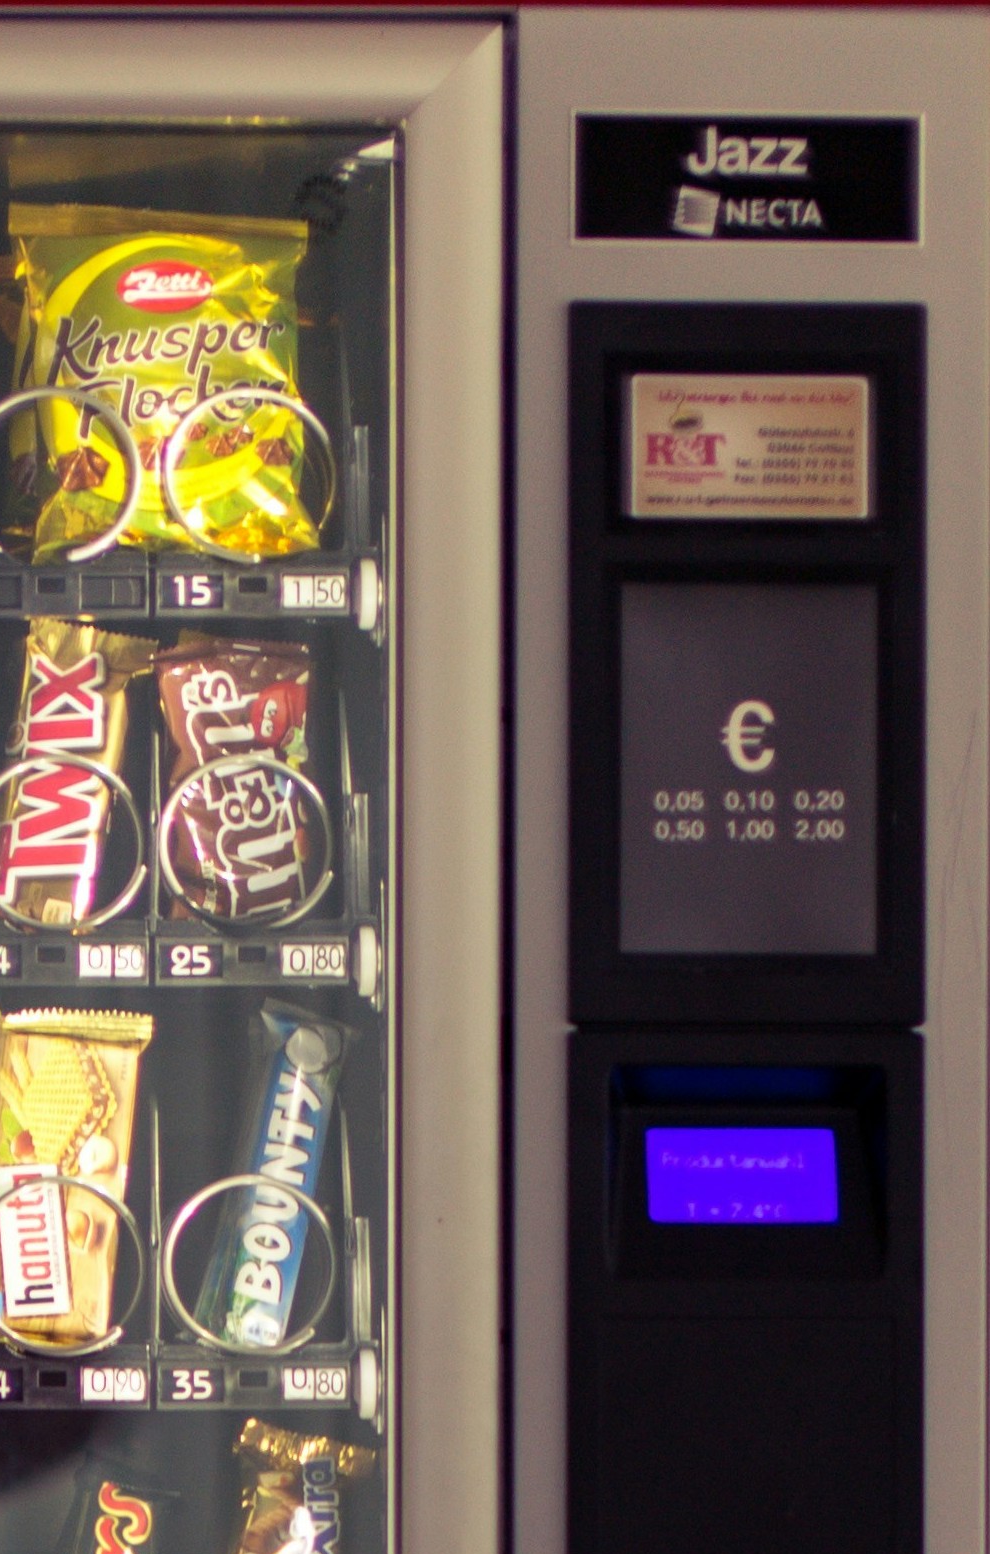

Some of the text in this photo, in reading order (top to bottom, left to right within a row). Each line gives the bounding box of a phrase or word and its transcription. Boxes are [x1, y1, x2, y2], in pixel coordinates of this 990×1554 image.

[686, 126, 809, 175] Jazz
[725, 198, 824, 228] NECTA
[46, 315, 286, 387] Knusper
[646, 432, 727, 466] R&T
[173, 577, 212, 606] 15
[720, 700, 776, 773] €
[655, 790, 846, 813] 0,05 0,10 0,20
[655, 819, 846, 842] 0,50 1,00 2,00
[170, 946, 211, 975] 25
[234, 1070, 324, 1306] BOUNTY
[6, 1173, 55, 1306] hanuta
[172, 1370, 212, 1399] 35
